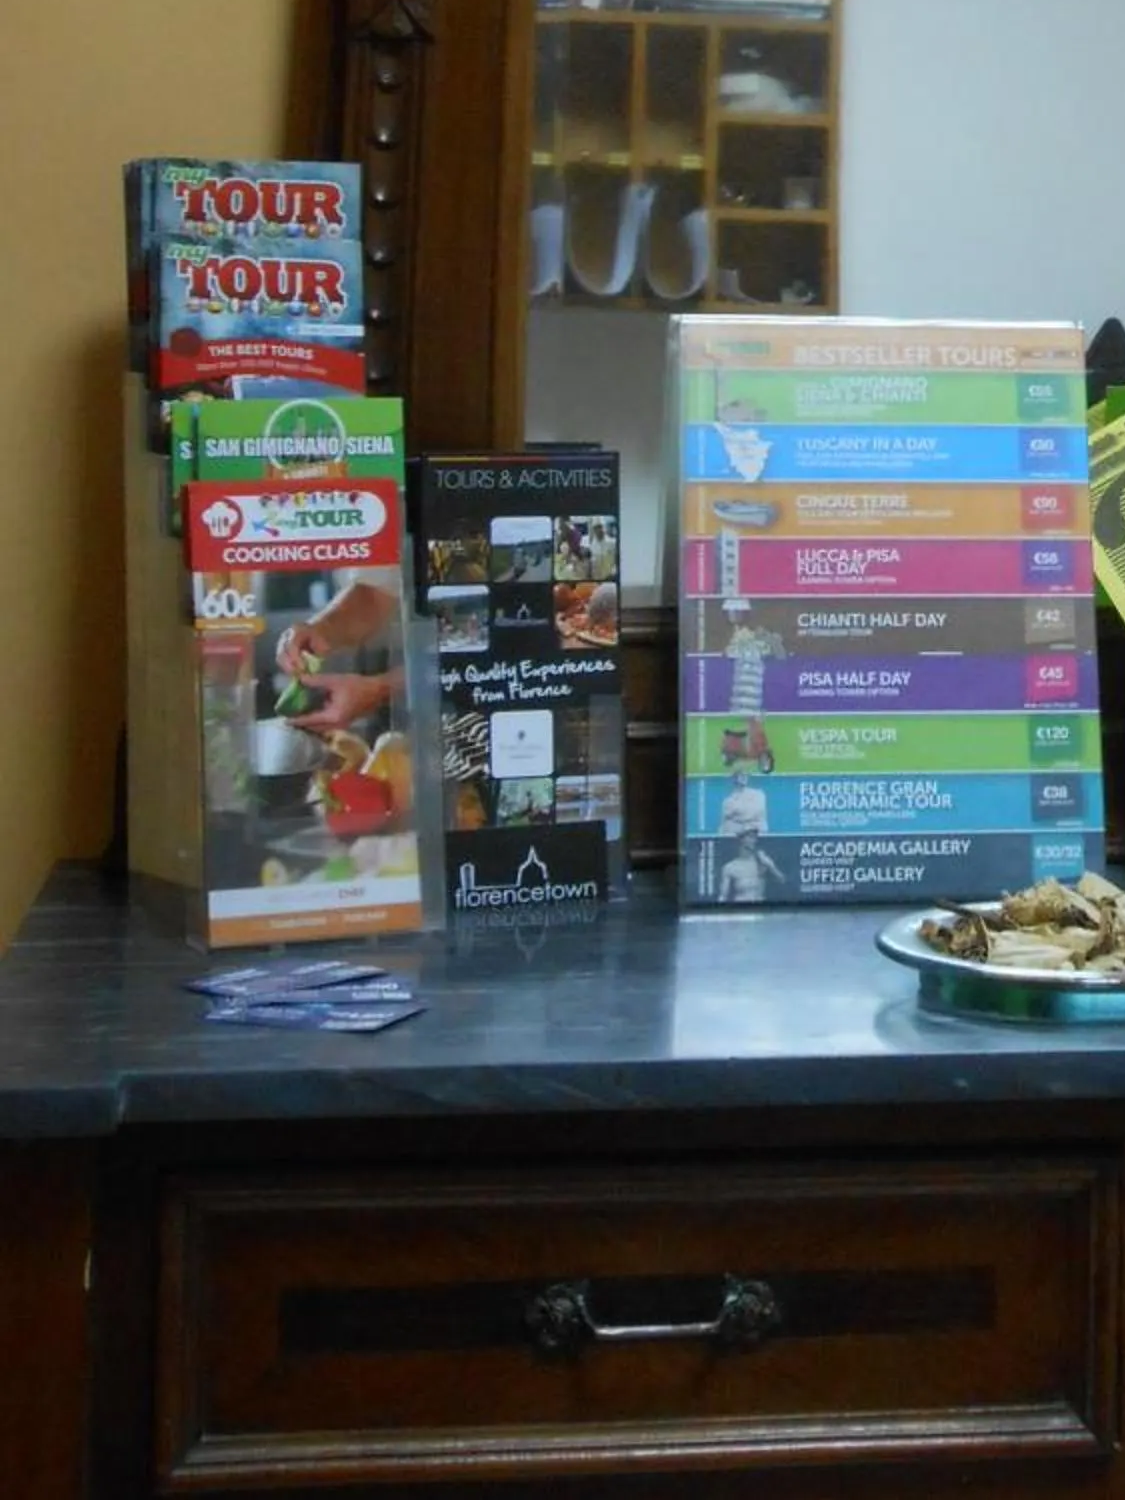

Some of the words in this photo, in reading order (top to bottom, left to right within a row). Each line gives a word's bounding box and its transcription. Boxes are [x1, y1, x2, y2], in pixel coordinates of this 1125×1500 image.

[174, 177, 346, 227] TOUR
[176, 255, 347, 305] TOUR
[208, 346, 233, 357] THE
[236, 343, 267, 356] BEST
[271, 345, 314, 360] TOURS
[793, 345, 932, 367] BESTSELLER
[939, 345, 1016, 367] TOURS
[206, 439, 239, 457] SAN
[243, 436, 339, 457] GIMIGNANO
[346, 435, 395, 455] SIENA
[906, 437, 938, 450] DAY
[436, 469, 494, 490] TOURS
[499, 469, 514, 488] &
[518, 468, 612, 488] ACTIVITIES
[295, 509, 365, 528] TOUR
[223, 545, 310, 563] COOKING
[314, 542, 371, 560] CLASS
[796, 548, 849, 563] LUCCA
[866, 549, 900, 563] PISA
[796, 562, 836, 576] FULL
[842, 562, 868, 576] DAY
[201, 587, 257, 620] 60€
[797, 613, 867, 629] CHIANTI
[869, 613, 912, 627] HALF
[915, 613, 948, 627] DAY
[465, 660, 517, 684] Quality
[520, 658, 617, 682] Experiences
[798, 672, 833, 687] PISA
[836, 672, 876, 686] HALF
[879, 671, 912, 686] DAY
[472, 686, 505, 704] from
[508, 682, 573, 701] Florence
[798, 729, 848, 744] VESPA
[851, 728, 898, 743] TOUR
[800, 781, 888, 795] FLORENCE
[890, 781, 938, 795] GRAN
[800, 794, 900, 810] PANORAMIC
[905, 794, 953, 809] TOUR
[799, 841, 897, 858] ACCADEMIA
[900, 839, 972, 856] GALLERY
[799, 867, 850, 883] UFFIZI
[853, 866, 926, 883] GALLERY
[455, 880, 598, 909] florencetown
